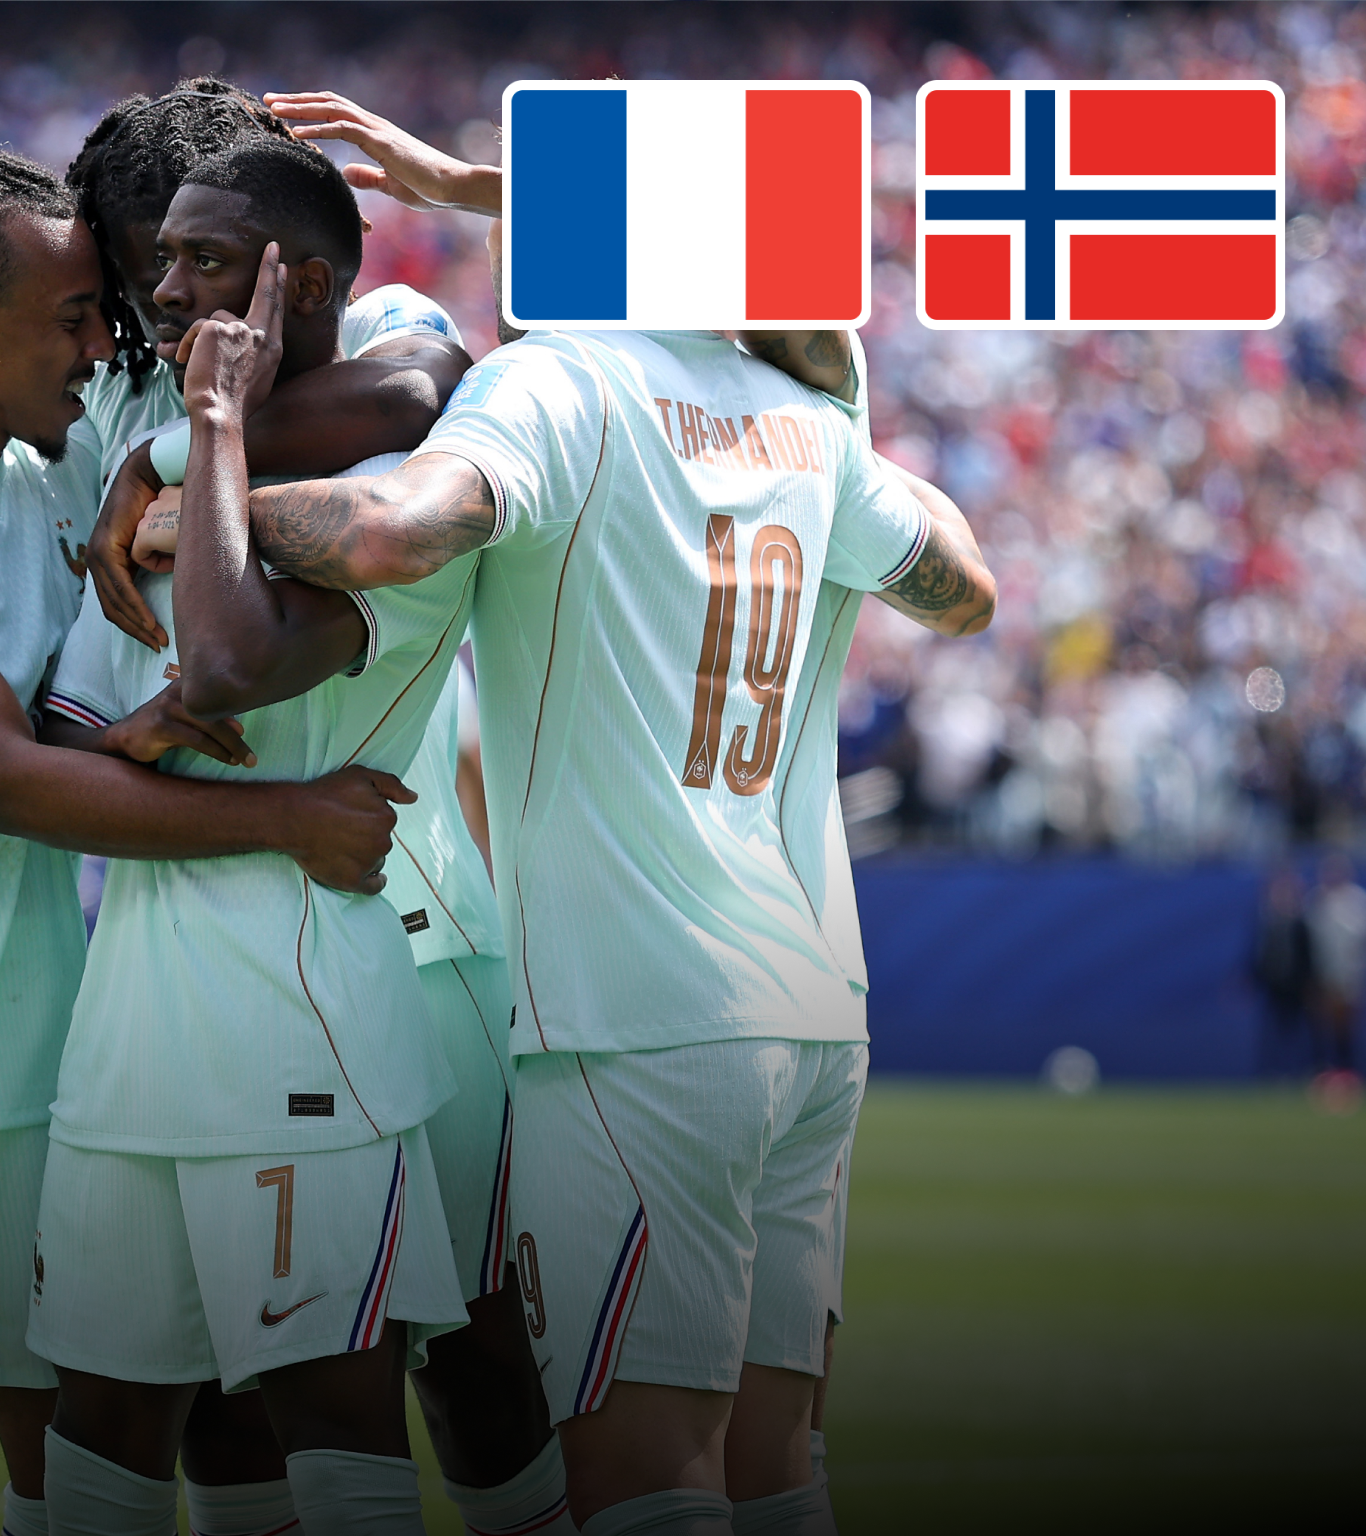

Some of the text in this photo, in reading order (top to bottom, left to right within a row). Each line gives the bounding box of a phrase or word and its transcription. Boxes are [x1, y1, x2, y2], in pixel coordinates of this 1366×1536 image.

[654, 397, 825, 475] T.HERNANDE
[681, 513, 803, 797] 19
[255, 1164, 295, 1279] 7
